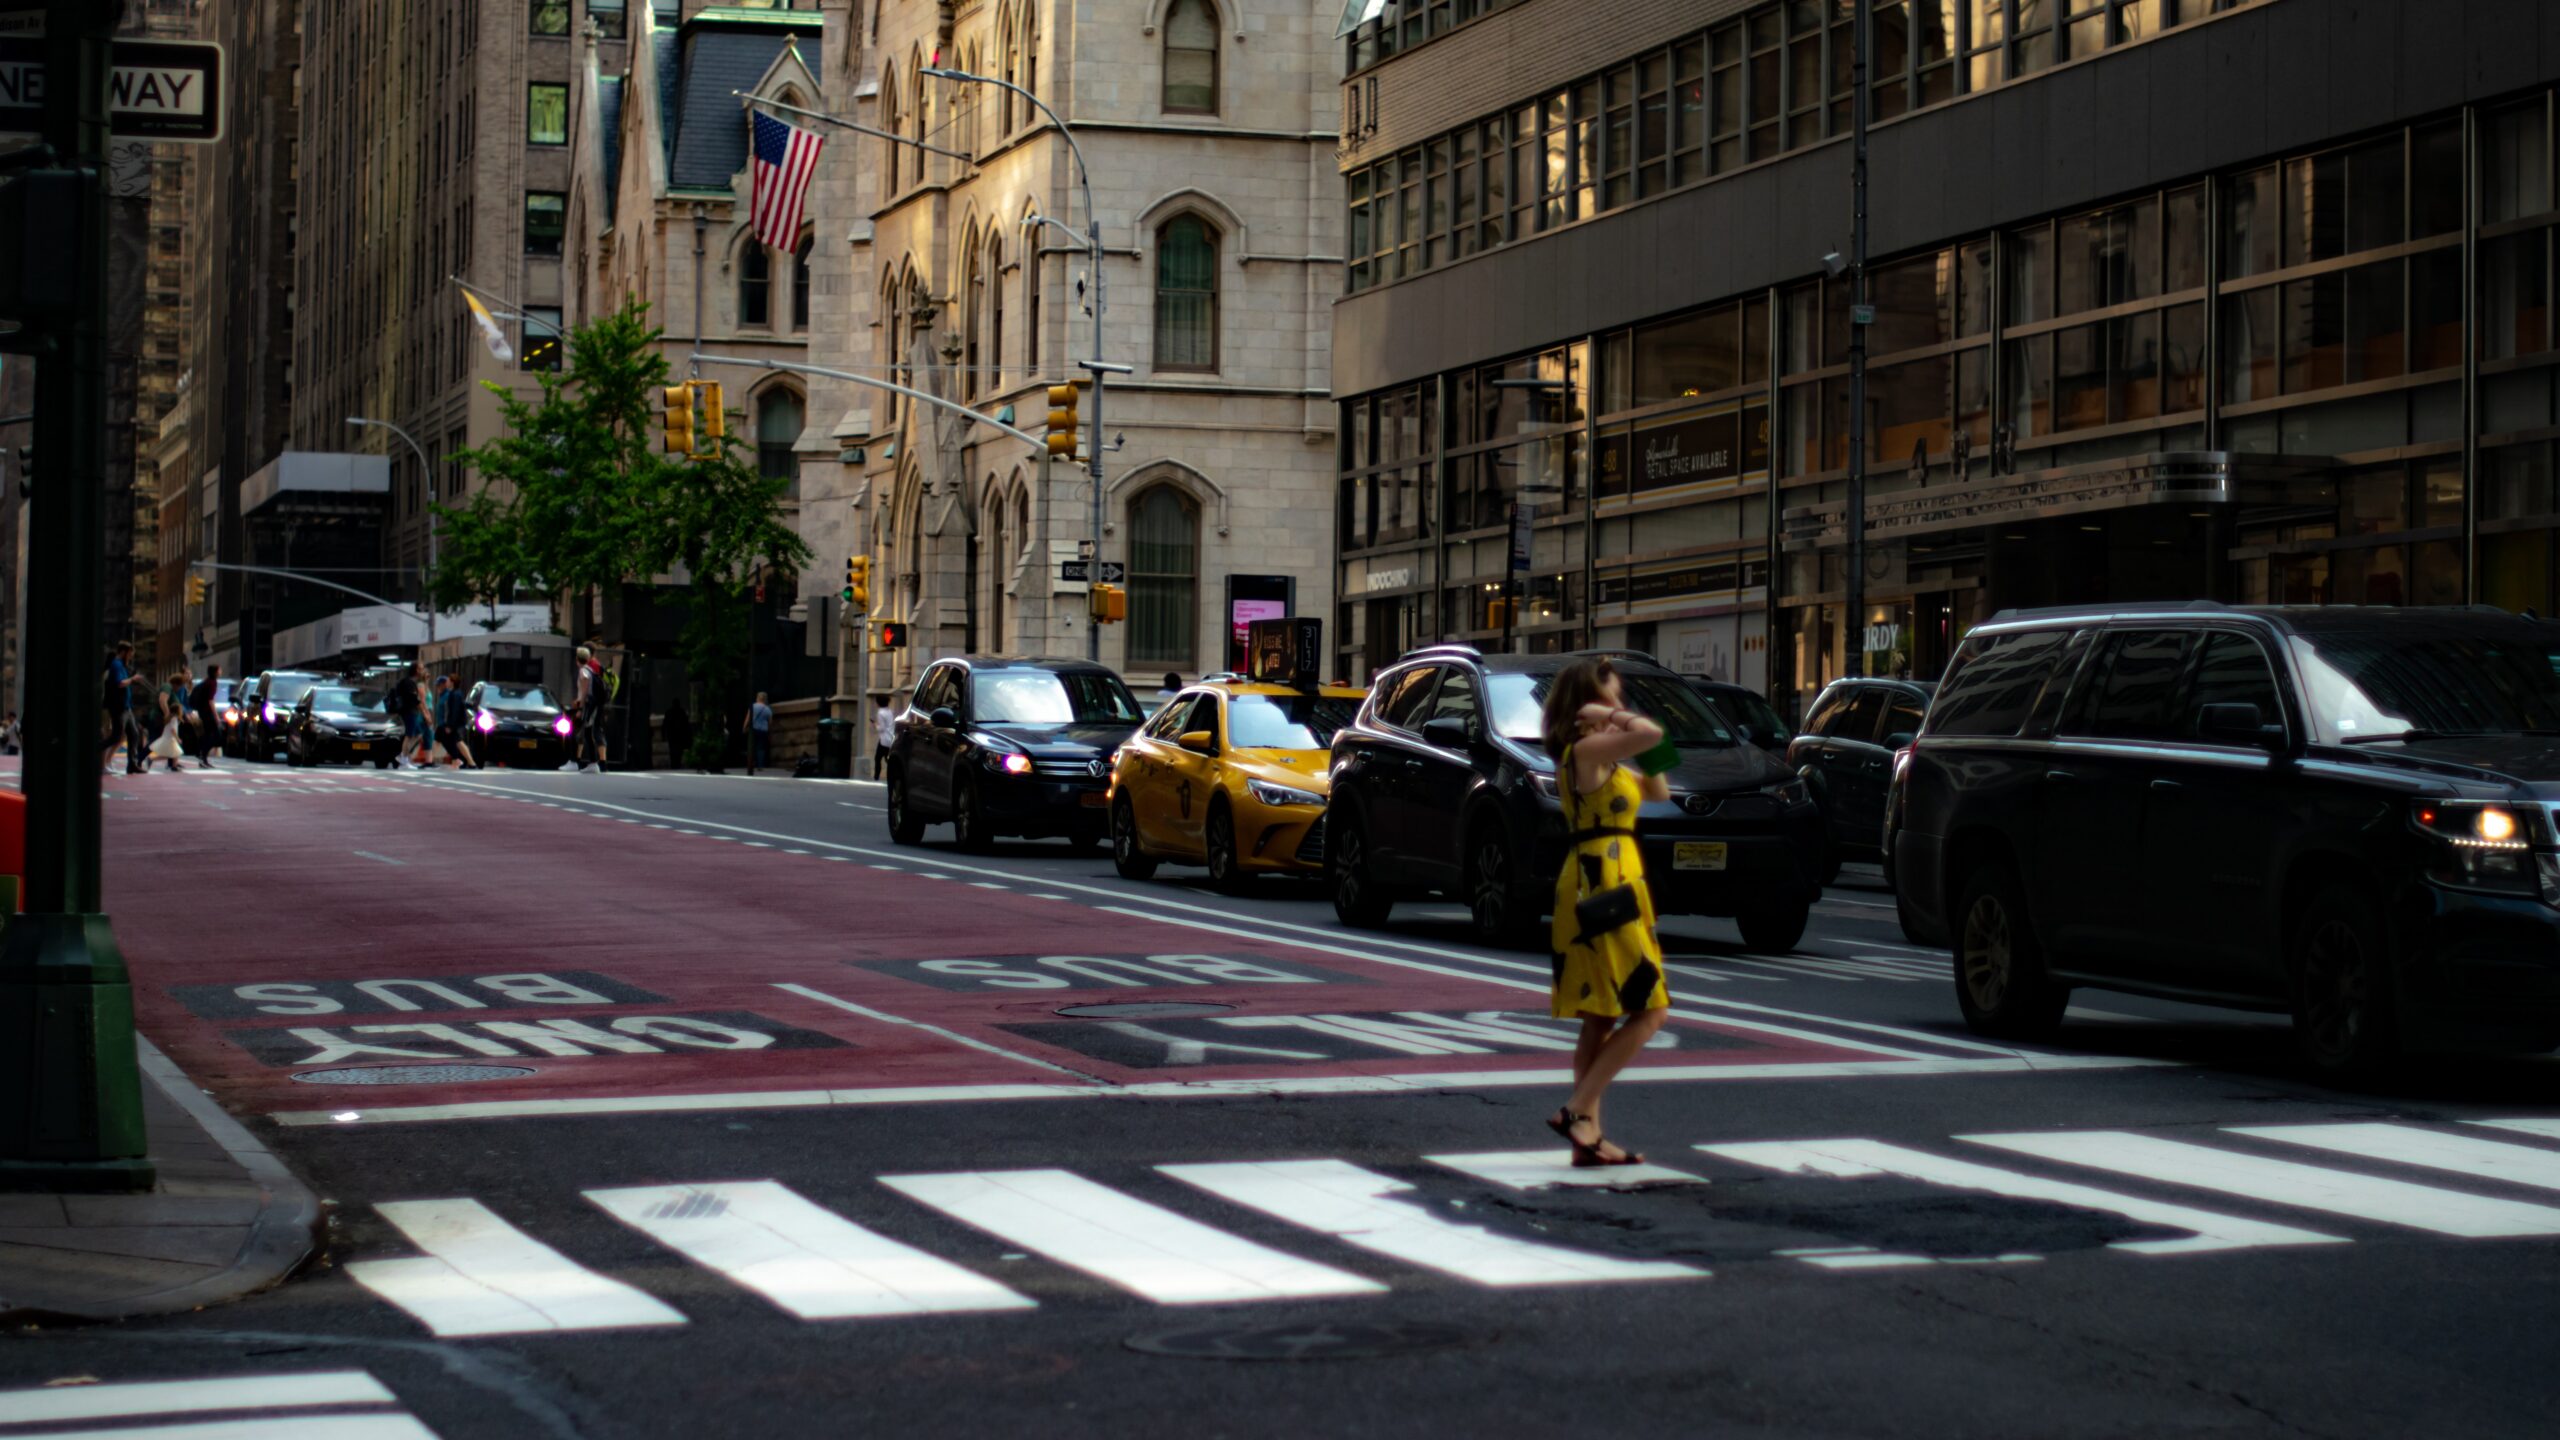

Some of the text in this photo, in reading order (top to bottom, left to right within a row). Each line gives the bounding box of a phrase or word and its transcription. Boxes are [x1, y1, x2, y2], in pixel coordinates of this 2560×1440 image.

[111, 72, 193, 108] WAY
[1670, 456, 1689, 476] SPACE
[1691, 449, 1728, 472] AVAILABLE
[1067, 566, 1086, 576] ONE
[1367, 568, 1408, 592] INDOCHINO
[916, 953, 1325, 990] BUS
[233, 972, 616, 1015] BUS
[286, 1015, 776, 1065] ONLY
